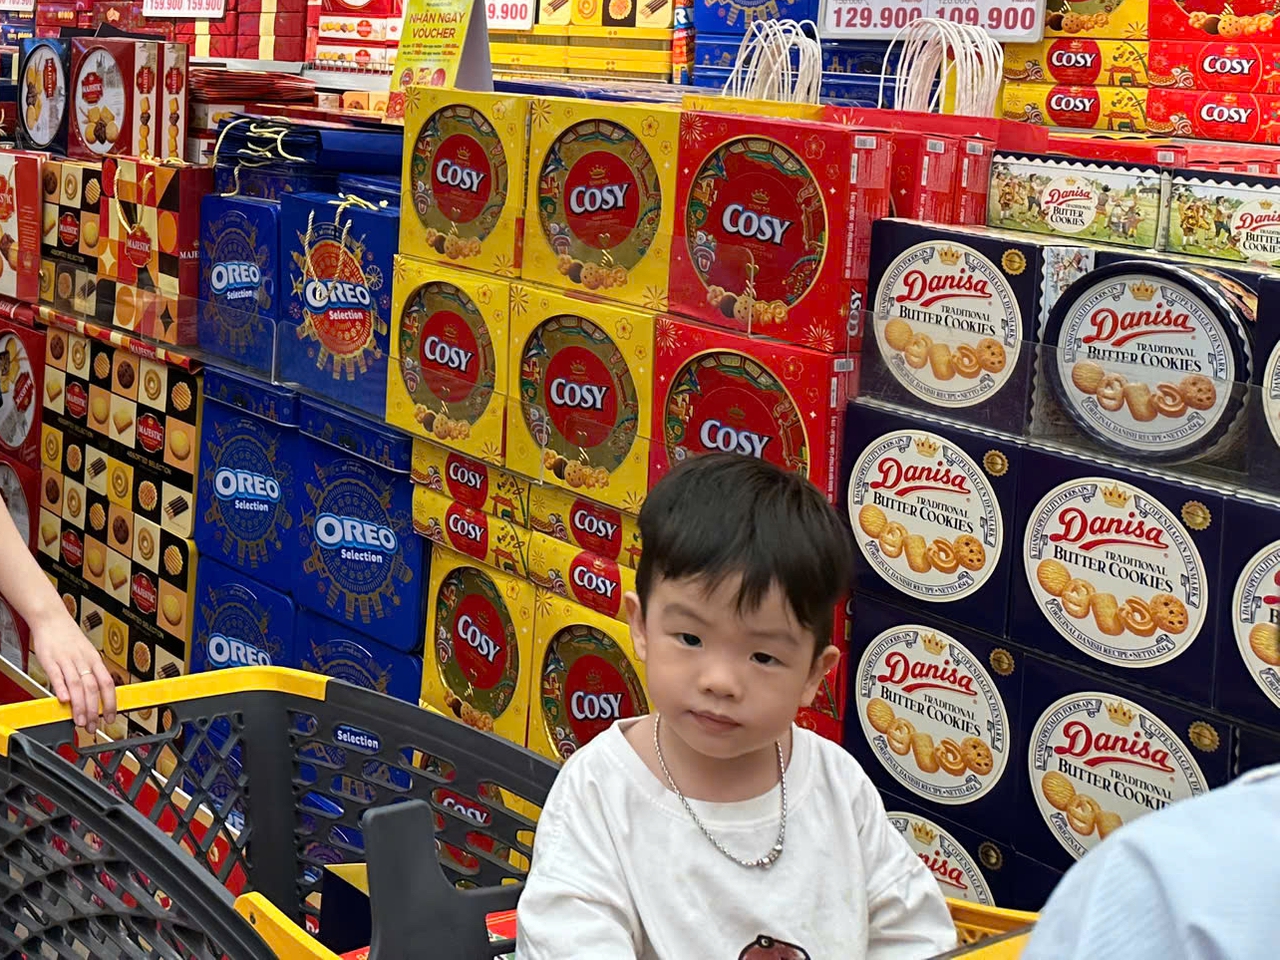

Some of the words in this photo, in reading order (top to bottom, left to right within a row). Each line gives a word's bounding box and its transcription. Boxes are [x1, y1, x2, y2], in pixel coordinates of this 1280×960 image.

[438, 12, 466, 24] NGAY
[833, 7, 923, 29] 129.900
[412, 28, 456, 39] VOUCHER
[1202, 55, 1255, 75] COSY
[1044, 186, 1093, 206] Danisa
[722, 204, 791, 246] COSY
[305, 279, 371, 306] OREO
[896, 268, 993, 308] Danisa
[328, 308, 363, 321] Selection
[899, 305, 942, 327] BUTTER
[944, 315, 996, 336] COOKIES
[941, 305, 992, 322] TRADITIONAL
[551, 377, 608, 411] COSY
[316, 516, 396, 550] OREO
[1049, 507, 1169, 552] Danisa
[340, 548, 383, 564] Selection
[1053, 544, 1106, 574] BUTTER
[1108, 561, 1173, 593] COOKIES
[1105, 551, 1168, 576] TRADITIONAL
[574, 567, 617, 598] COSY
[571, 690, 623, 720] COSY
[337, 729, 378, 749] Selection
